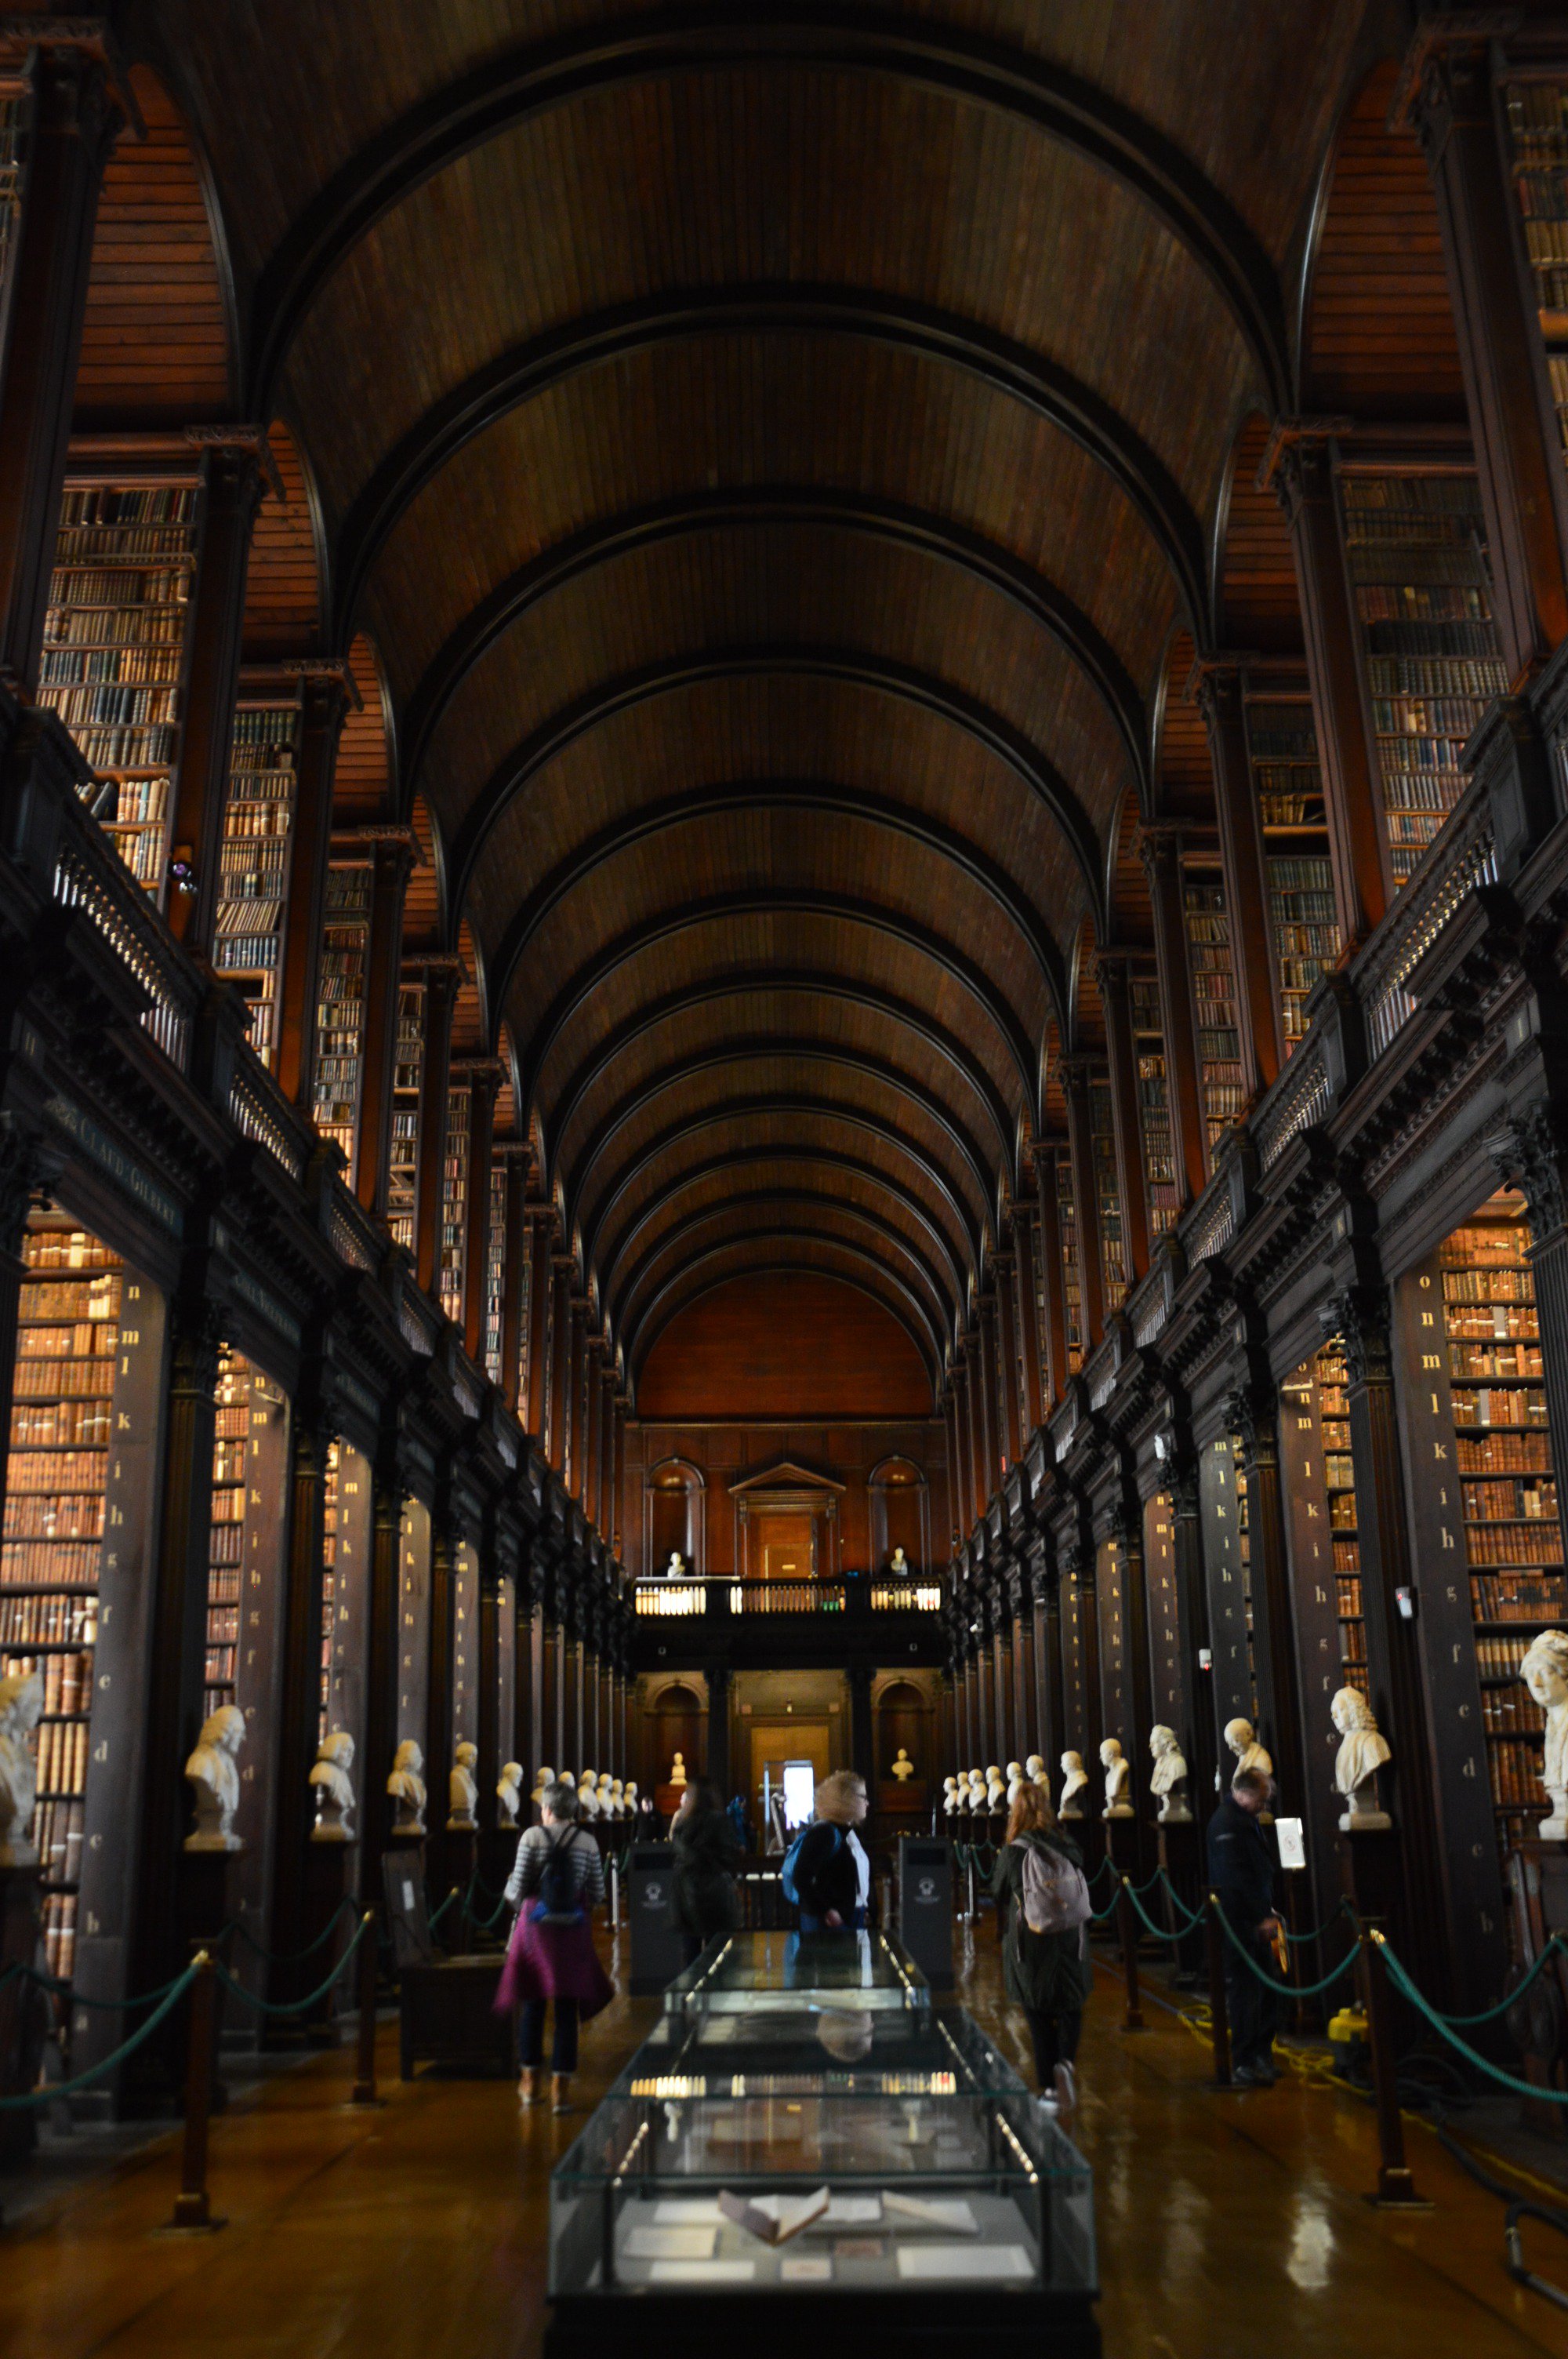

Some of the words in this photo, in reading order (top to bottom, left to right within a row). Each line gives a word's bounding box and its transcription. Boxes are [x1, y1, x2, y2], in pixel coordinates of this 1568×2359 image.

[1419, 1276, 1431, 1289] o
[128, 1285, 140, 1300] n
[1421, 1312, 1434, 1326] n
[122, 1330, 140, 1345] m
[121, 1356, 129, 1376] l
[1421, 1354, 1441, 1369] m
[255, 1376, 266, 1389] n
[1300, 1392, 1311, 1404] n
[1430, 1393, 1439, 1414] l
[118, 1412, 131, 1430] k
[252, 1412, 267, 1425] m
[1298, 1417, 1312, 1430] m
[252, 1439, 259, 1456] l
[1214, 1441, 1227, 1451] m
[1433, 1442, 1448, 1459] k
[114, 1459, 121, 1479] i
[1305, 1461, 1312, 1478] l
[1218, 1469, 1225, 1485] l
[344, 1482, 358, 1494] m
[250, 1489, 261, 1504] k
[1439, 1487, 1447, 1506] i
[110, 1504, 123, 1525] h
[1216, 1505, 1226, 1518] k
[1307, 1503, 1319, 1518] k
[1156, 1524, 1167, 1534] m
[252, 1532, 258, 1548] i
[1224, 1536, 1229, 1550] i
[1441, 1527, 1455, 1549] h
[343, 1539, 352, 1554] k
[1312, 1542, 1319, 1558] i
[107, 1553, 118, 1568] g
[1221, 1568, 1232, 1582] h
[1161, 1577, 1169, 1589] k
[1315, 1585, 1327, 1602] h
[1446, 1587, 1457, 1602] g
[102, 1605, 113, 1624] f
[1319, 1638, 1328, 1651] g
[1453, 1644, 1461, 1663] f
[98, 1674, 111, 1690] e
[1322, 1676, 1330, 1691] f
[93, 1739, 108, 1762] d
[1462, 1757, 1476, 1778] d
[86, 1910, 100, 1934] b
[1480, 1911, 1494, 1933] b
